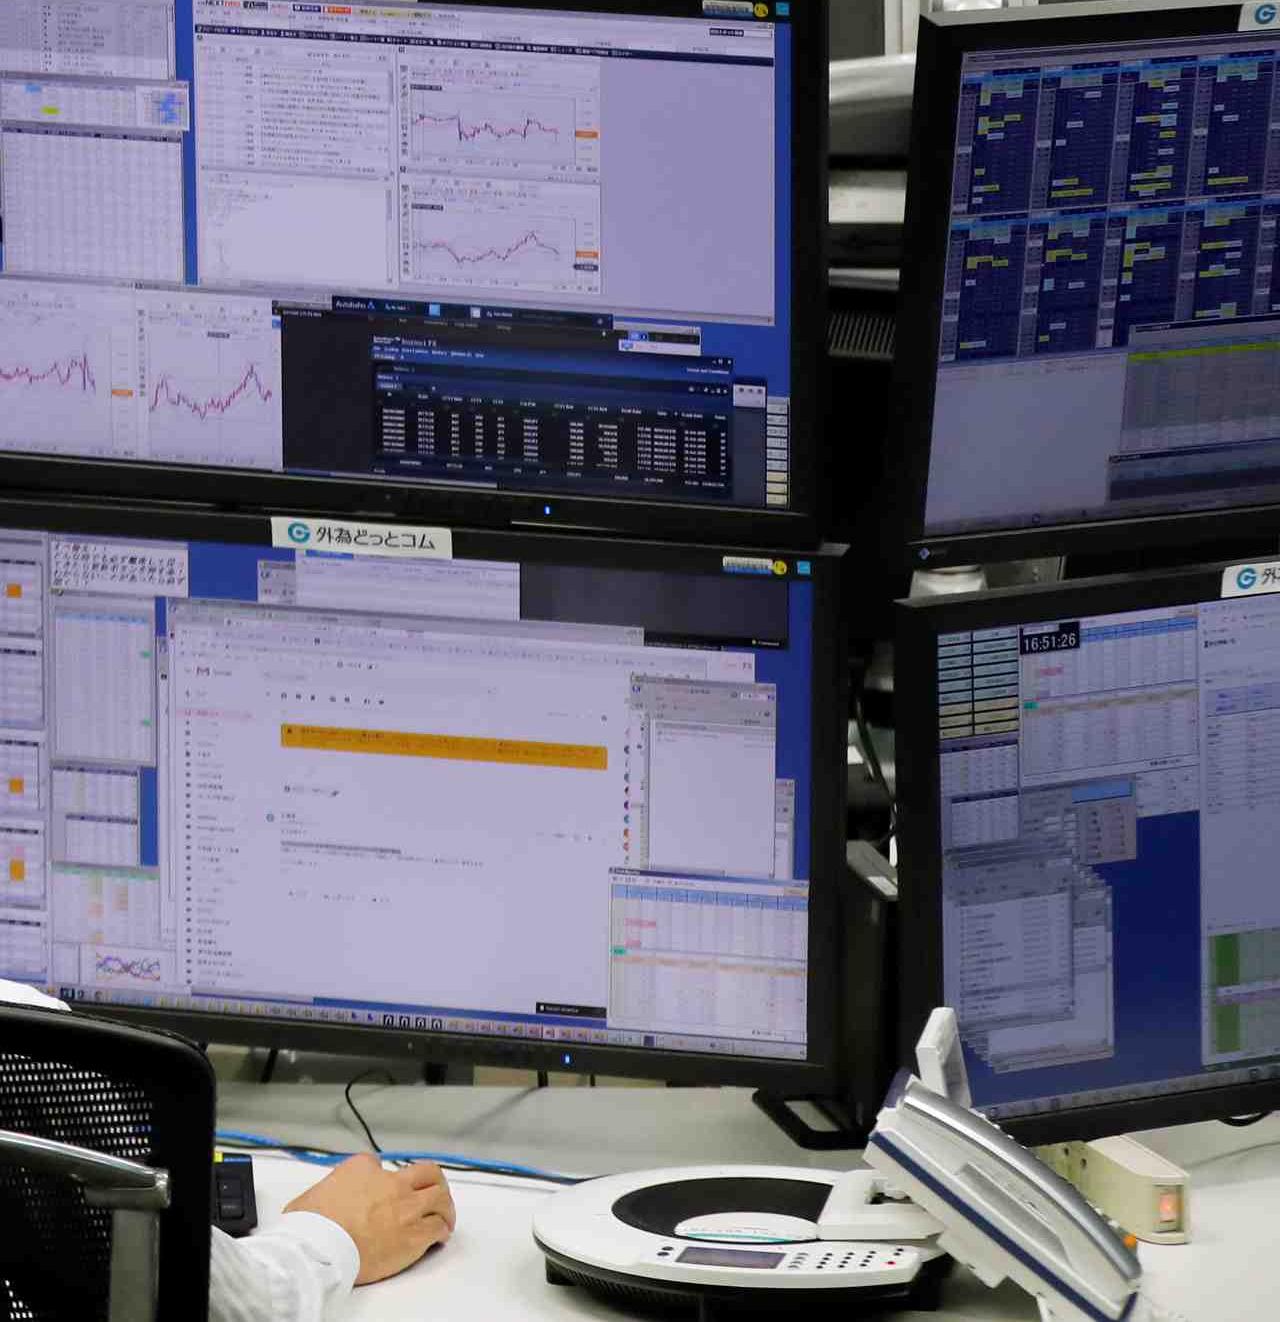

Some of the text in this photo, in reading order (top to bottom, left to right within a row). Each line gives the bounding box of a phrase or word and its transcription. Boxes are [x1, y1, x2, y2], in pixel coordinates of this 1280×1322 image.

[315, 526, 436, 551] 外為どっとコム
[1023, 632, 1077, 652] 16:51:26
